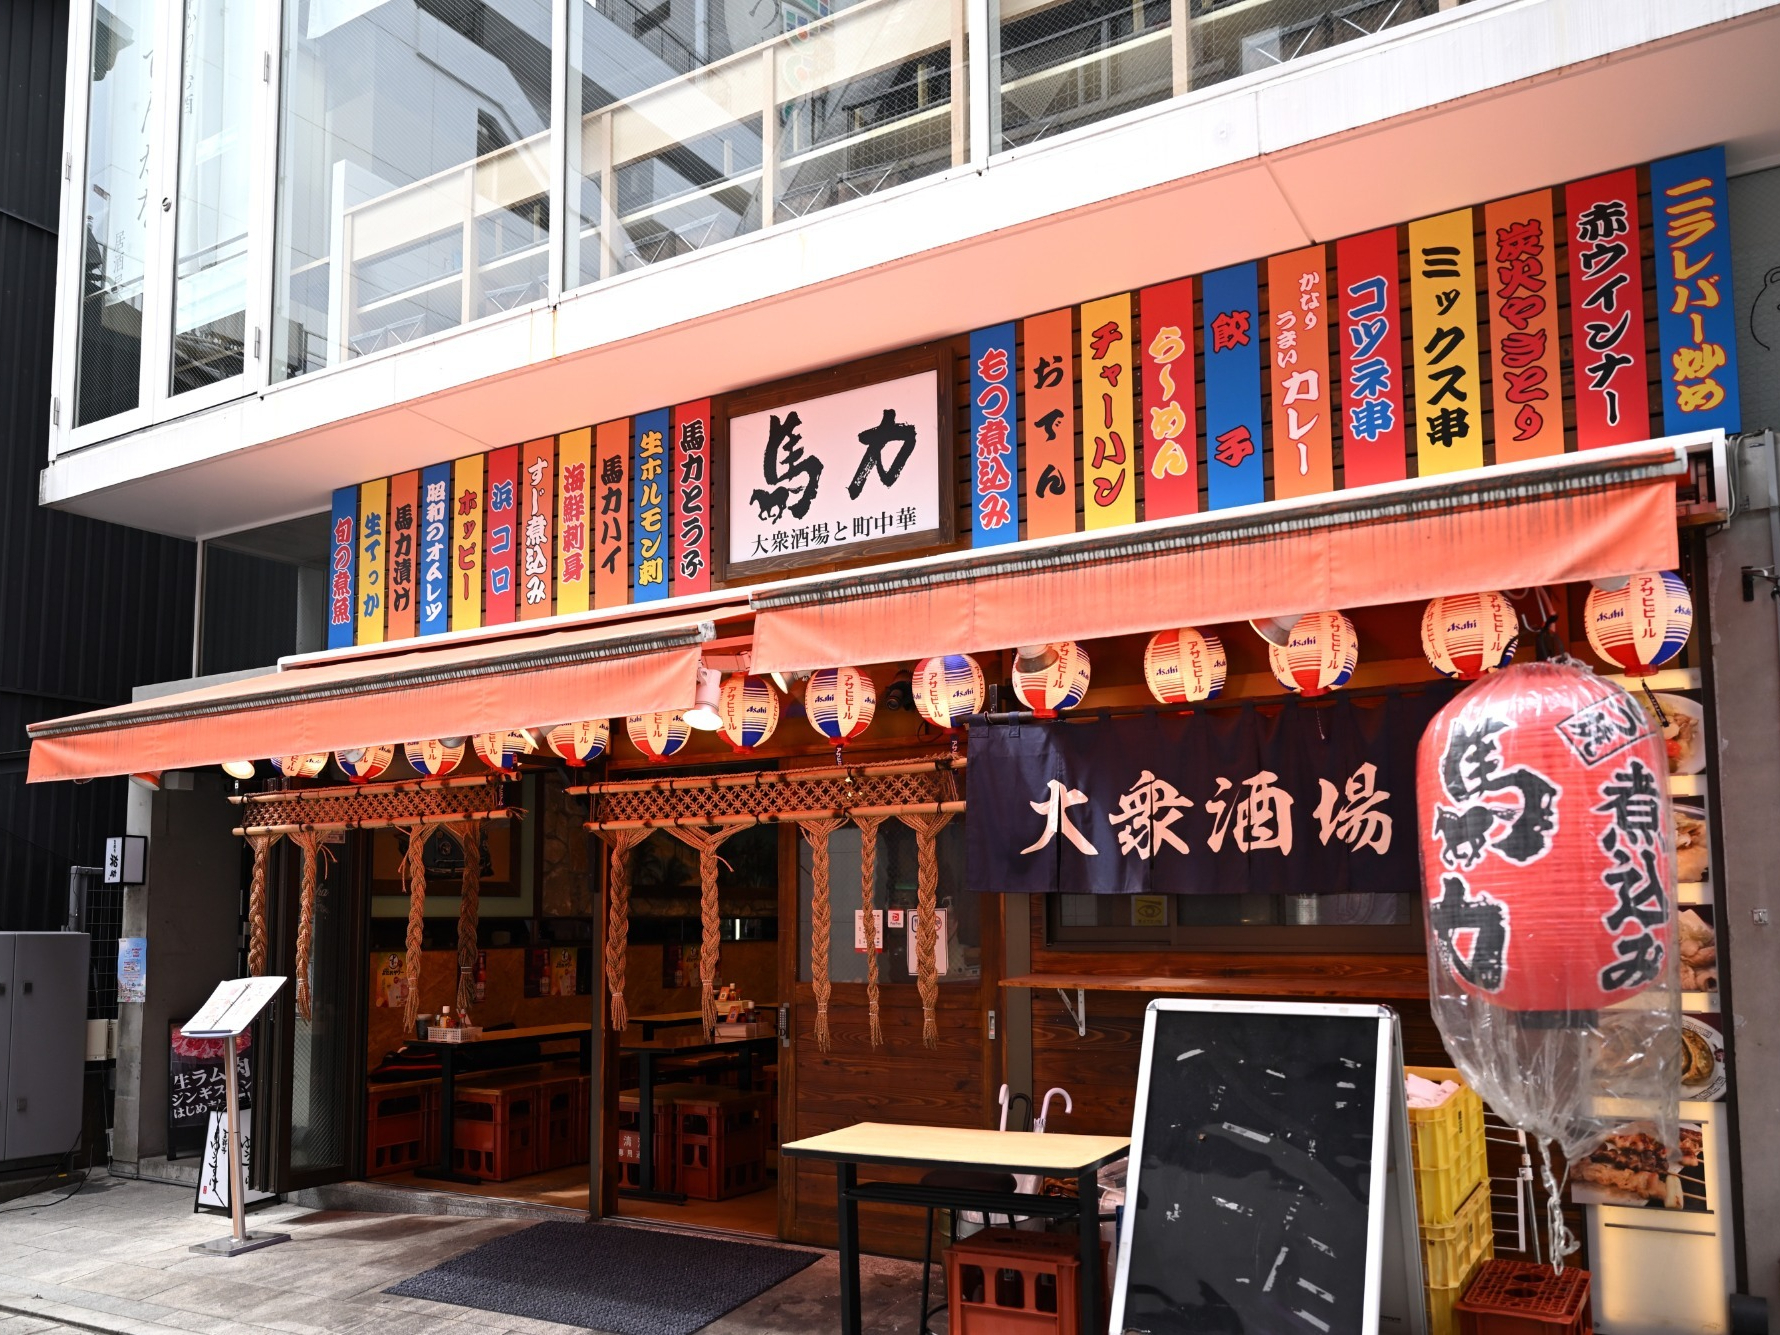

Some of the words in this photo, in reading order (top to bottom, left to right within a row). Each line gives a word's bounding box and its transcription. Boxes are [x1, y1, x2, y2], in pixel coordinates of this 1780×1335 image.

[1276, 310, 1298, 368] うまい
[1299, 271, 1320, 331] かなり
[1421, 246, 1470, 448] ミックス串
[1496, 218, 1549, 441] 炭火やきとり
[1578, 199, 1634, 426] 赤ウインナー
[1666, 177, 1726, 413] ニラレバー炒め
[1210, 310, 1254, 467] 餃子
[1348, 274, 1394, 441] コツネ串
[750, 409, 917, 524] 馬力
[977, 348, 1011, 529] もつ煮込み
[1034, 356, 1066, 498] おでん
[1090, 321, 1126, 506] チャーハン
[1281, 370, 1320, 475] カレー
[425, 479, 447, 622] 昭和のオムレツ
[458, 489, 478, 601] ホッピー
[491, 479, 514, 595] 浜コロ
[525, 456, 549, 605] すじ煮込み
[562, 462, 586, 583] 海鮮刺身
[600, 454, 623, 575] 馬力ハイ
[638, 430, 664, 586] 生ホルモン刺
[680, 418, 706, 579] 馬力とうふ
[751, 507, 916, 556] 大衆酒場と町中華
[331, 516, 353, 626] 旬の煮魚
[364, 512, 382, 618] 生てっか
[393, 504, 414, 613] 馬力漬け
[1639, 577, 1656, 639] アサヒビール
[1053, 641, 1070, 689] アサヒビール
[1188, 641, 1204, 694] アサヒビール
[1290, 636, 1316, 648] Asahi
[1328, 615, 1341, 670] アサヒビール
[1447, 620, 1476, 632] Asahi
[1487, 594, 1503, 652] アサヒビール
[1596, 608, 1624, 622] Asahi
[727, 686, 738, 731] アサヒビール
[746, 705, 767, 714] Asahi
[814, 693, 835, 703] Asahi
[843, 674, 853, 720] アサヒビール
[929, 672, 943, 718] アサヒビール
[952, 688, 974, 698] Asahi
[1156, 664, 1178, 676] Asahi
[1020, 762, 1393, 861] 大衆酒場
[1431, 717, 1562, 994] 馬力
[1590, 758, 1670, 994] 煮込み
[172, 1079, 252, 1107] ジンギスン
